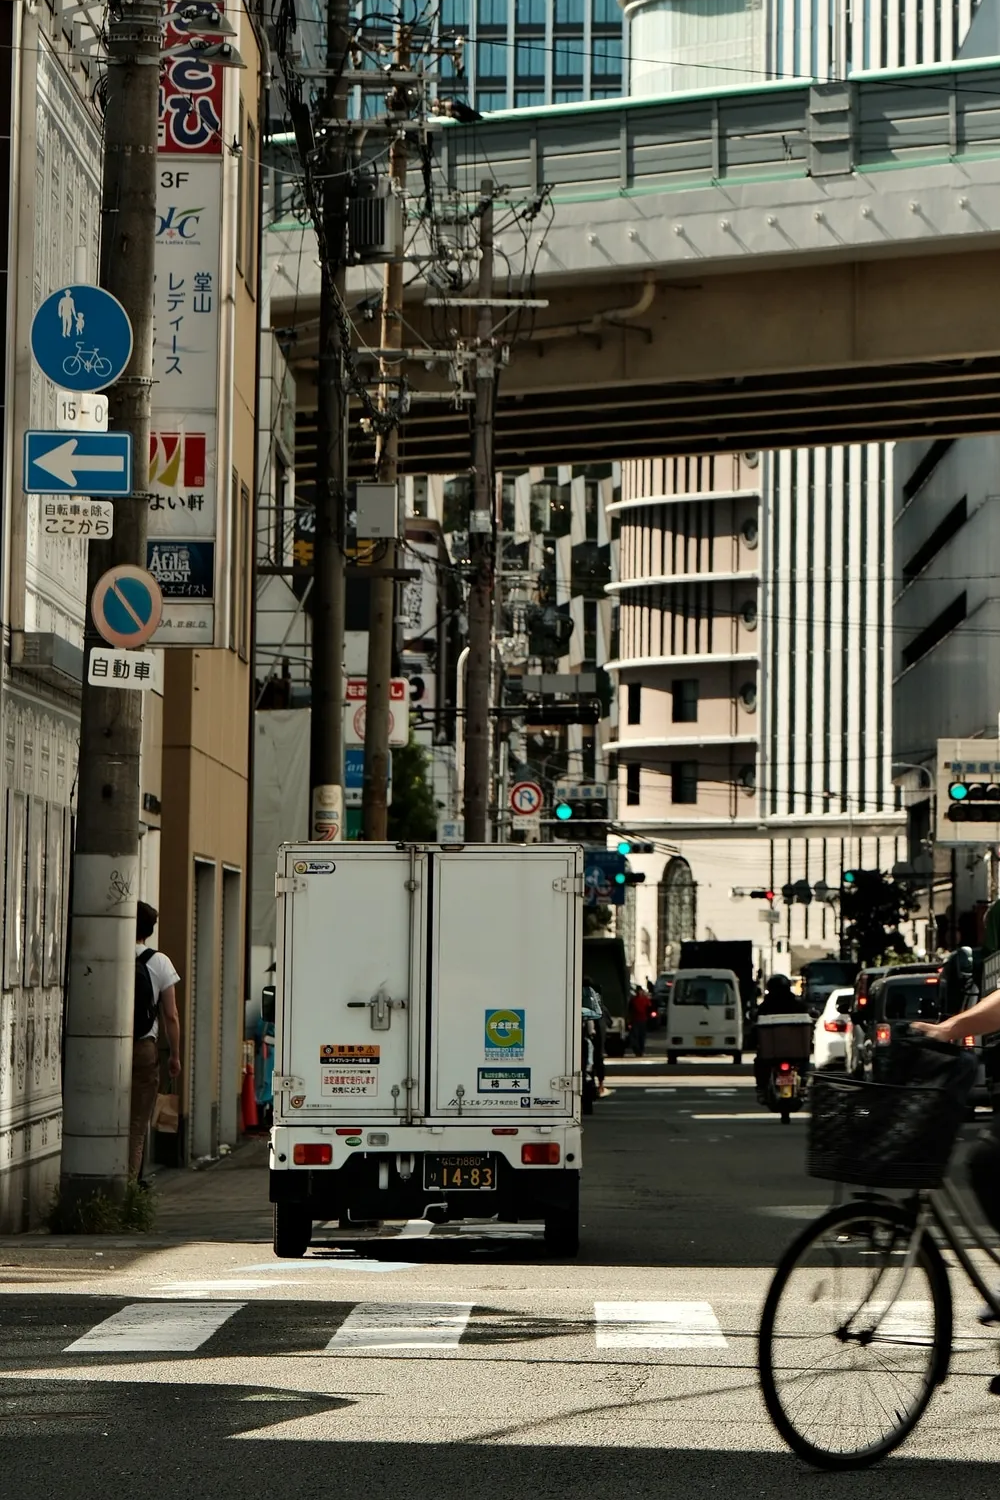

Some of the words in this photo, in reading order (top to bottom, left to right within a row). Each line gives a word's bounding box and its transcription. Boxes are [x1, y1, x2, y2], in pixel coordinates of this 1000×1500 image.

[160, 171, 190, 189] 3F
[193, 272, 212, 313] 堂山
[165, 272, 186, 375] レディース
[45, 504, 110, 518] 自転車を除く
[147, 493, 204, 512] よい軒
[45, 518, 109, 536] ここから
[92, 657, 151, 680] 自動車
[348, 685, 403, 698] もみし
[443, 1168, 492, 1186] 14-83
